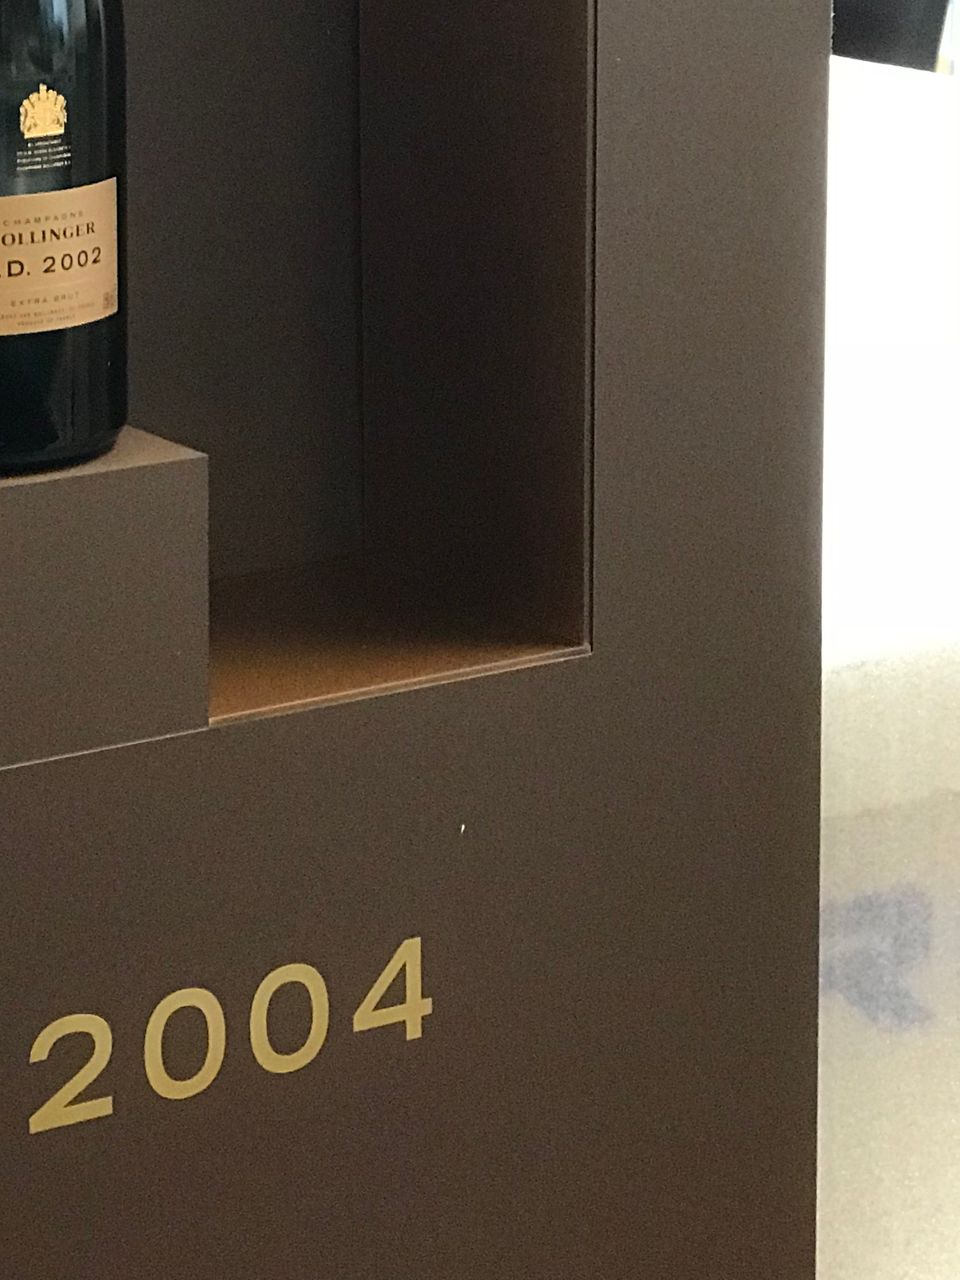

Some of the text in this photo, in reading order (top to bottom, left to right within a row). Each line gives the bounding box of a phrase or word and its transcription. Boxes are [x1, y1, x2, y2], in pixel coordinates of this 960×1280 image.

[2, 210, 83, 227] CHAMPAGNE
[42, 246, 101, 274] 2002
[10, 297, 48, 308] EXTRA
[28, 937, 433, 1134] 2004
